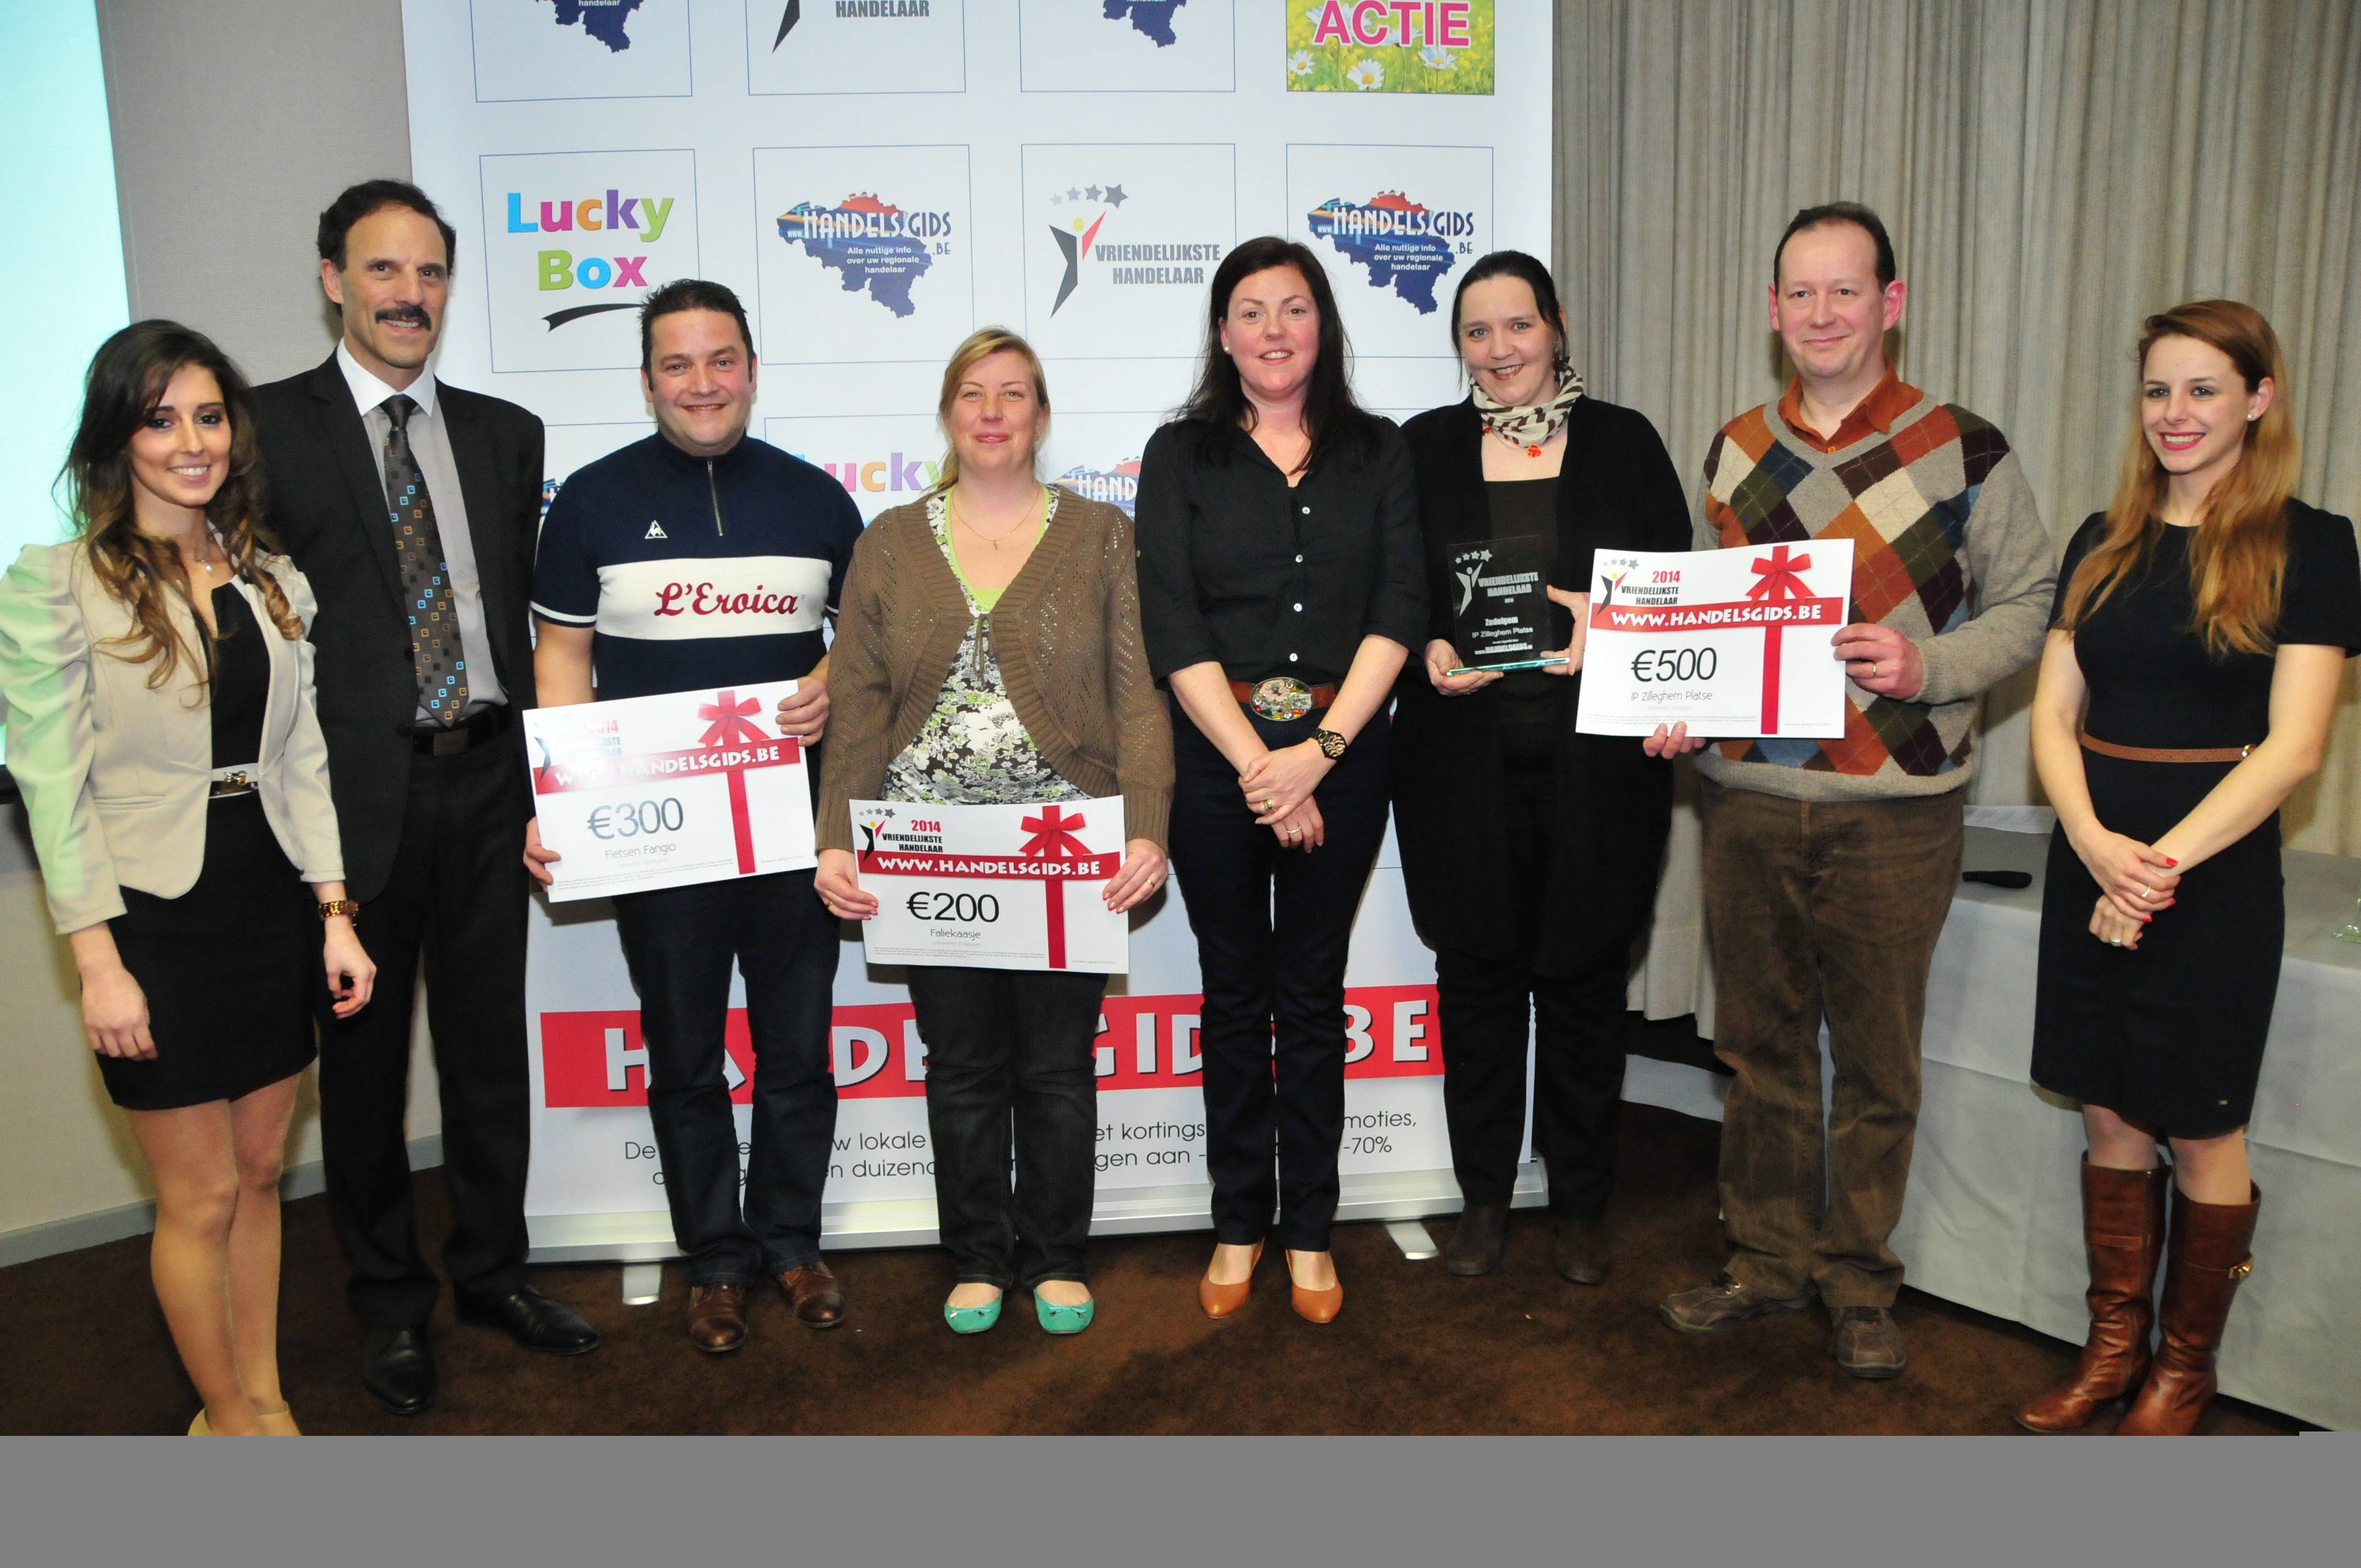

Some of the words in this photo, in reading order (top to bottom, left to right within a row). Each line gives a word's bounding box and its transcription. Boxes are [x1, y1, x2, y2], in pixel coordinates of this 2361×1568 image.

[836, 1, 929, 18] HANDELAAR
[1313, 0, 1471, 46] ACTIE
[508, 189, 674, 242] Lucky
[866, 247, 894, 256] nuttige
[1095, 244, 1221, 262] VRIENDELIJKSTE
[1392, 244, 1419, 253] nuttige
[881, 255, 920, 266] regionale
[1406, 254, 1443, 263] regionale
[538, 250, 648, 291] Box
[1113, 267, 1204, 284] HANDELAAR
[1652, 570, 1680, 583] 2014
[1487, 584, 1532, 597] HANDELAAR
[1621, 585, 1679, 595] VRIENDELIJKSTE
[654, 582, 798, 616] L'Eroica
[1611, 605, 1821, 627] WWW.HANDELSGIDS.BE
[1631, 647, 1717, 682] €500
[1642, 690, 1683, 703] Zilleghem
[1685, 689, 1713, 700] Platse
[587, 797, 683, 840] €300
[911, 819, 942, 832] 2014
[882, 833, 943, 843] VRIENDELIJKSTE
[605, 848, 641, 859] Fietsen
[643, 842, 676, 855] Fangio
[899, 843, 943, 853] HANDELAAR
[877, 857, 1100, 875] WWW.HANDELSGIDS.BE
[906, 891, 999, 923] €200
[930, 928, 981, 940] Faliekaasje
[860, 1131, 926, 1150] lokale
[1122, 1121, 1205, 1141] kortings
[1344, 1110, 1416, 1129] moties,
[1146, 1150, 1190, 1165] aan
[1343, 1136, 1392, 1155] -70%
